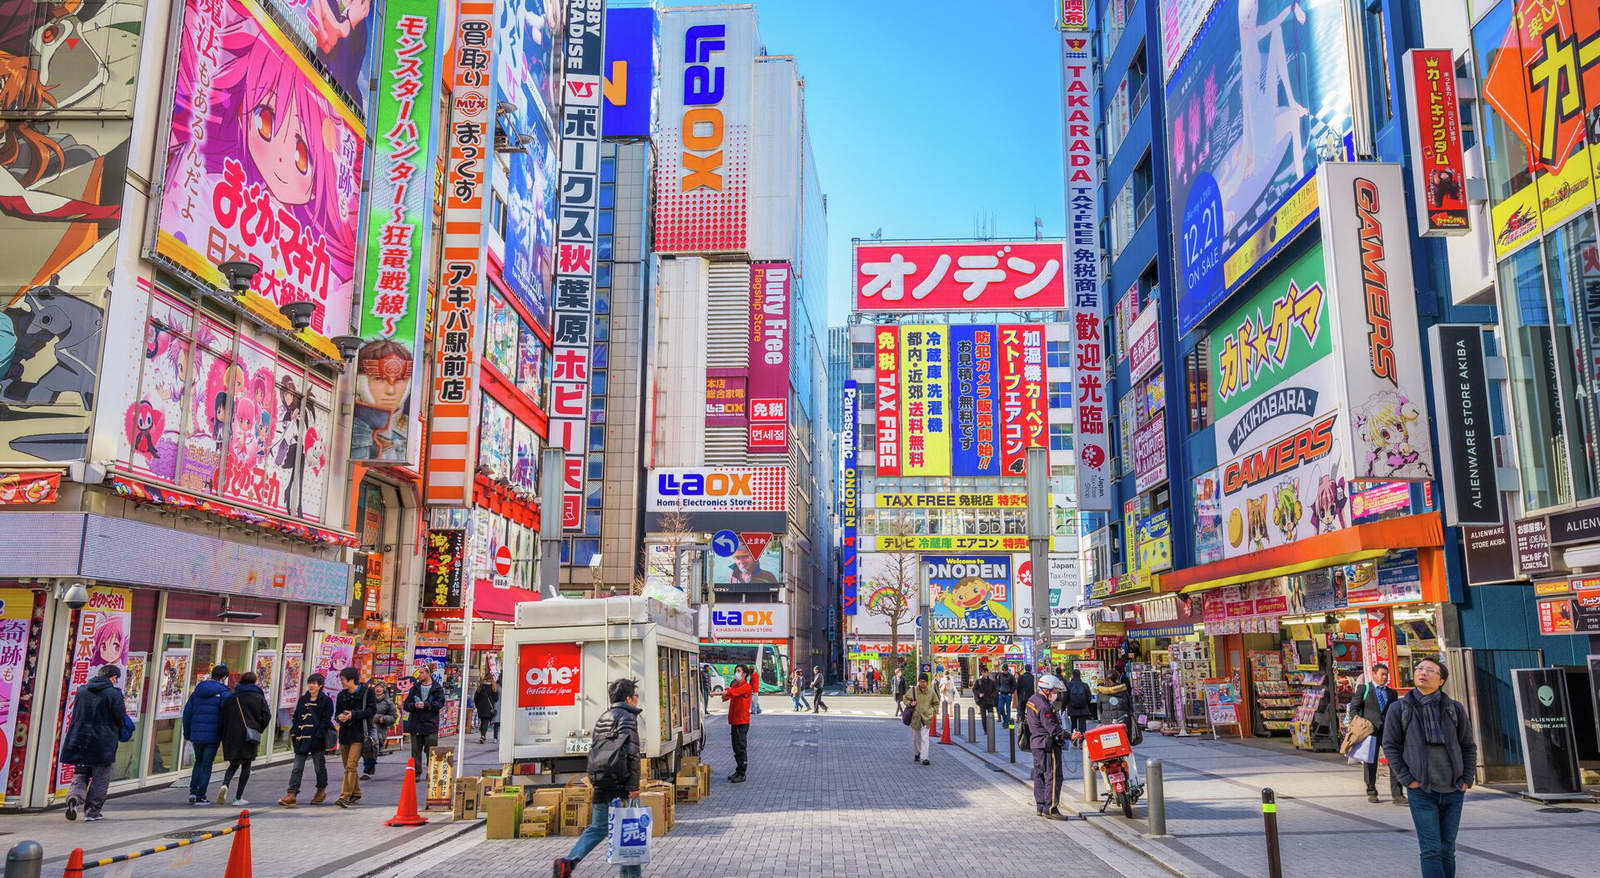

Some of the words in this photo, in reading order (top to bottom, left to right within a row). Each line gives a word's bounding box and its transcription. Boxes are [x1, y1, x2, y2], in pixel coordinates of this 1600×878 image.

[461, 22, 488, 87] 買取り
[1067, 66, 1092, 181] TAKARADA
[1426, 69, 1449, 165] カードキングダム
[453, 122, 480, 202] まっくす
[1071, 188, 1094, 245] TAX-FREE
[1184, 200, 1219, 268] 12.21
[753, 268, 764, 311] Flagship
[860, 245, 1060, 302] オノデン
[1074, 249, 1097, 307] 免税商店
[1188, 269, 1200, 289] ON
[1201, 247, 1219, 277] SALE
[1353, 177, 1398, 387] GAMERS
[763, 268, 788, 316] Duty
[441, 263, 473, 402] アキバ駅前店
[753, 313, 764, 342] Store
[764, 318, 787, 365] Free
[878, 331, 896, 371] 免税
[1076, 312, 1104, 434] 歓迎光臨
[1458, 339, 1470, 378] AKIBA
[753, 402, 784, 417] 免税
[879, 374, 896, 411] TAX
[958, 340, 973, 450] お見積り無料です
[1002, 330, 1023, 455] ストーブエアコン
[1461, 383, 1474, 426] STORE
[752, 429, 785, 441] 면세점
[844, 388, 856, 459] Panasonic
[1235, 391, 1306, 441] AKIHABARA
[879, 416, 897, 468] FREE
[1224, 414, 1338, 496] GAMERS
[1464, 429, 1482, 509] ALIENWARE
[683, 498, 728, 506] Electronics
[730, 498, 752, 506] Store
[845, 468, 856, 527] ONODEN
[884, 496, 913, 506] TAX
[917, 496, 956, 506] FREE
[959, 494, 994, 506] 免税店
[884, 538, 915, 549] テレビ
[918, 537, 953, 548] 冷蔵庫
[956, 537, 999, 548] エアコン
[1470, 526, 1505, 538] ALIENWARE
[1472, 540, 1490, 549] STORE
[1490, 537, 1506, 548] AKIBA
[928, 563, 1007, 579] ONODEN
[1060, 580, 1077, 588] Shop
[929, 634, 1010, 645] Kテレビはオノデンで!
[934, 618, 1009, 629] KIHABARA
[1018, 616, 1078, 629] ODEN
[937, 645, 998, 653] オノデン
[622, 822, 646, 844] 売る
